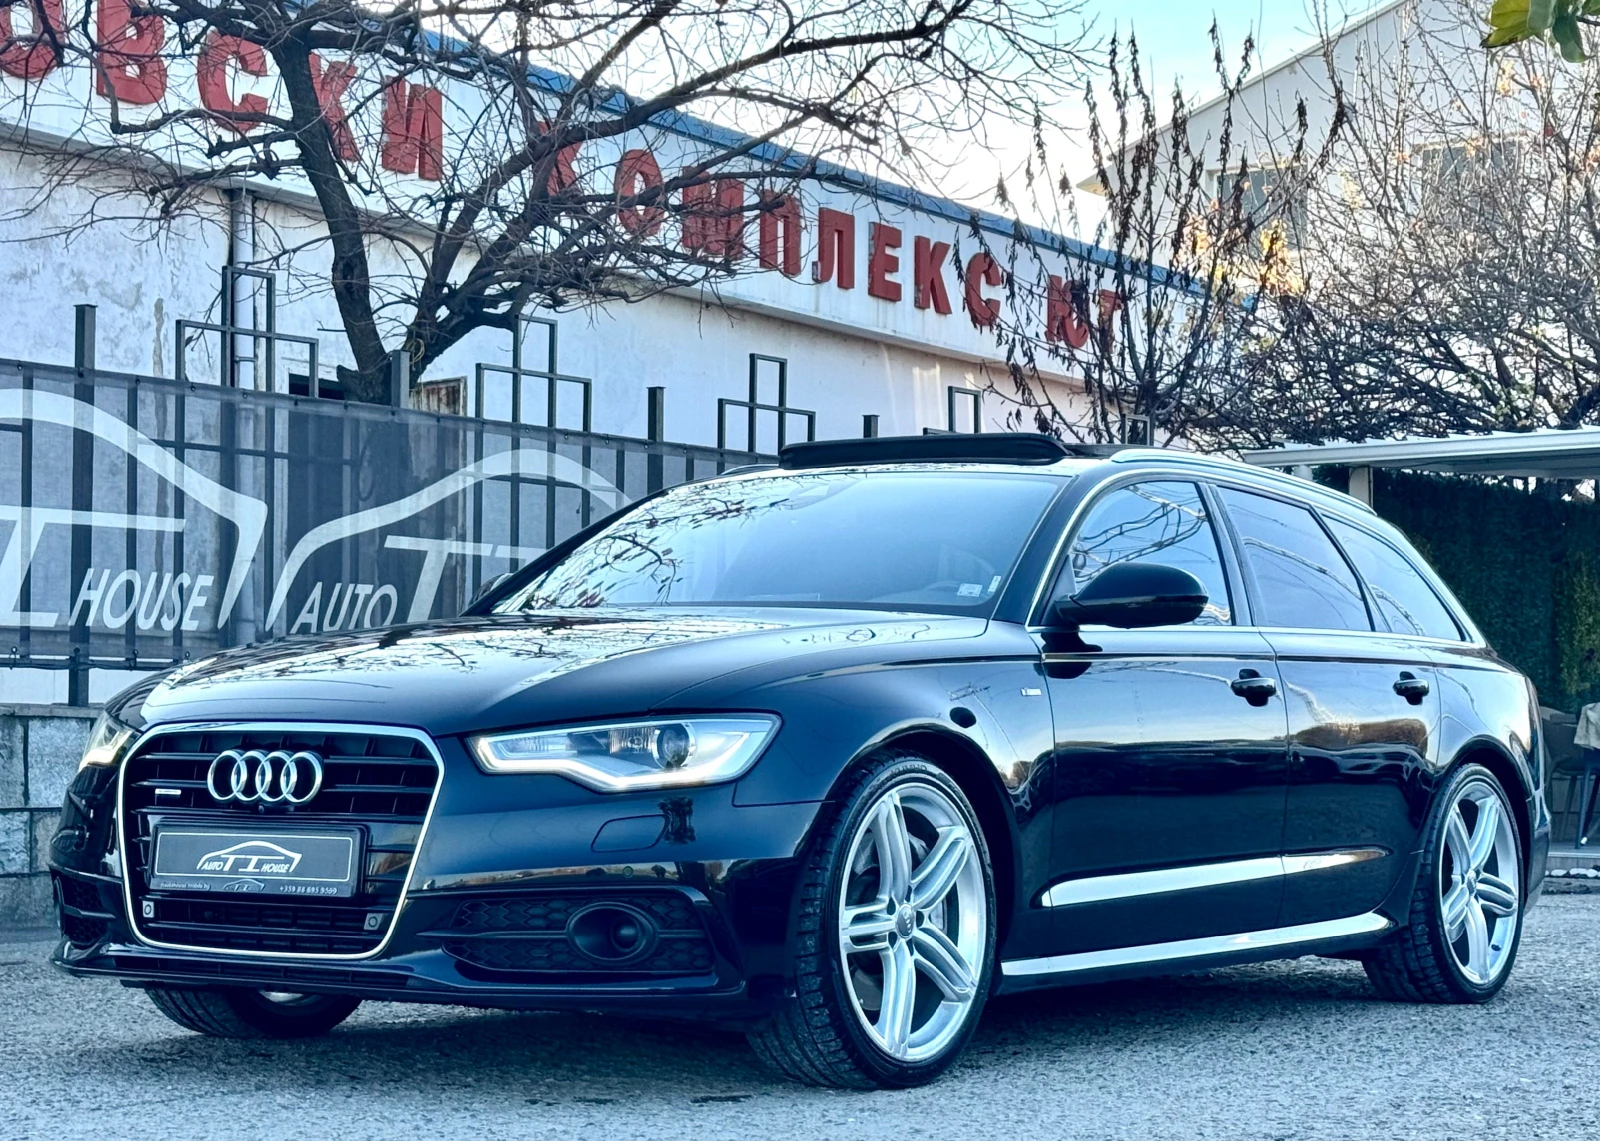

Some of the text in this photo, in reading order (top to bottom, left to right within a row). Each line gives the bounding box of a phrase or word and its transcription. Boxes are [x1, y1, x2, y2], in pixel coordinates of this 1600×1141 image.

[68, 568, 214, 631] HOUSE
[289, 581, 398, 634] AUTO
[201, 861, 224, 871] AUTO
[260, 863, 290, 873] HOUSE
[279, 885, 296, 893] +359
